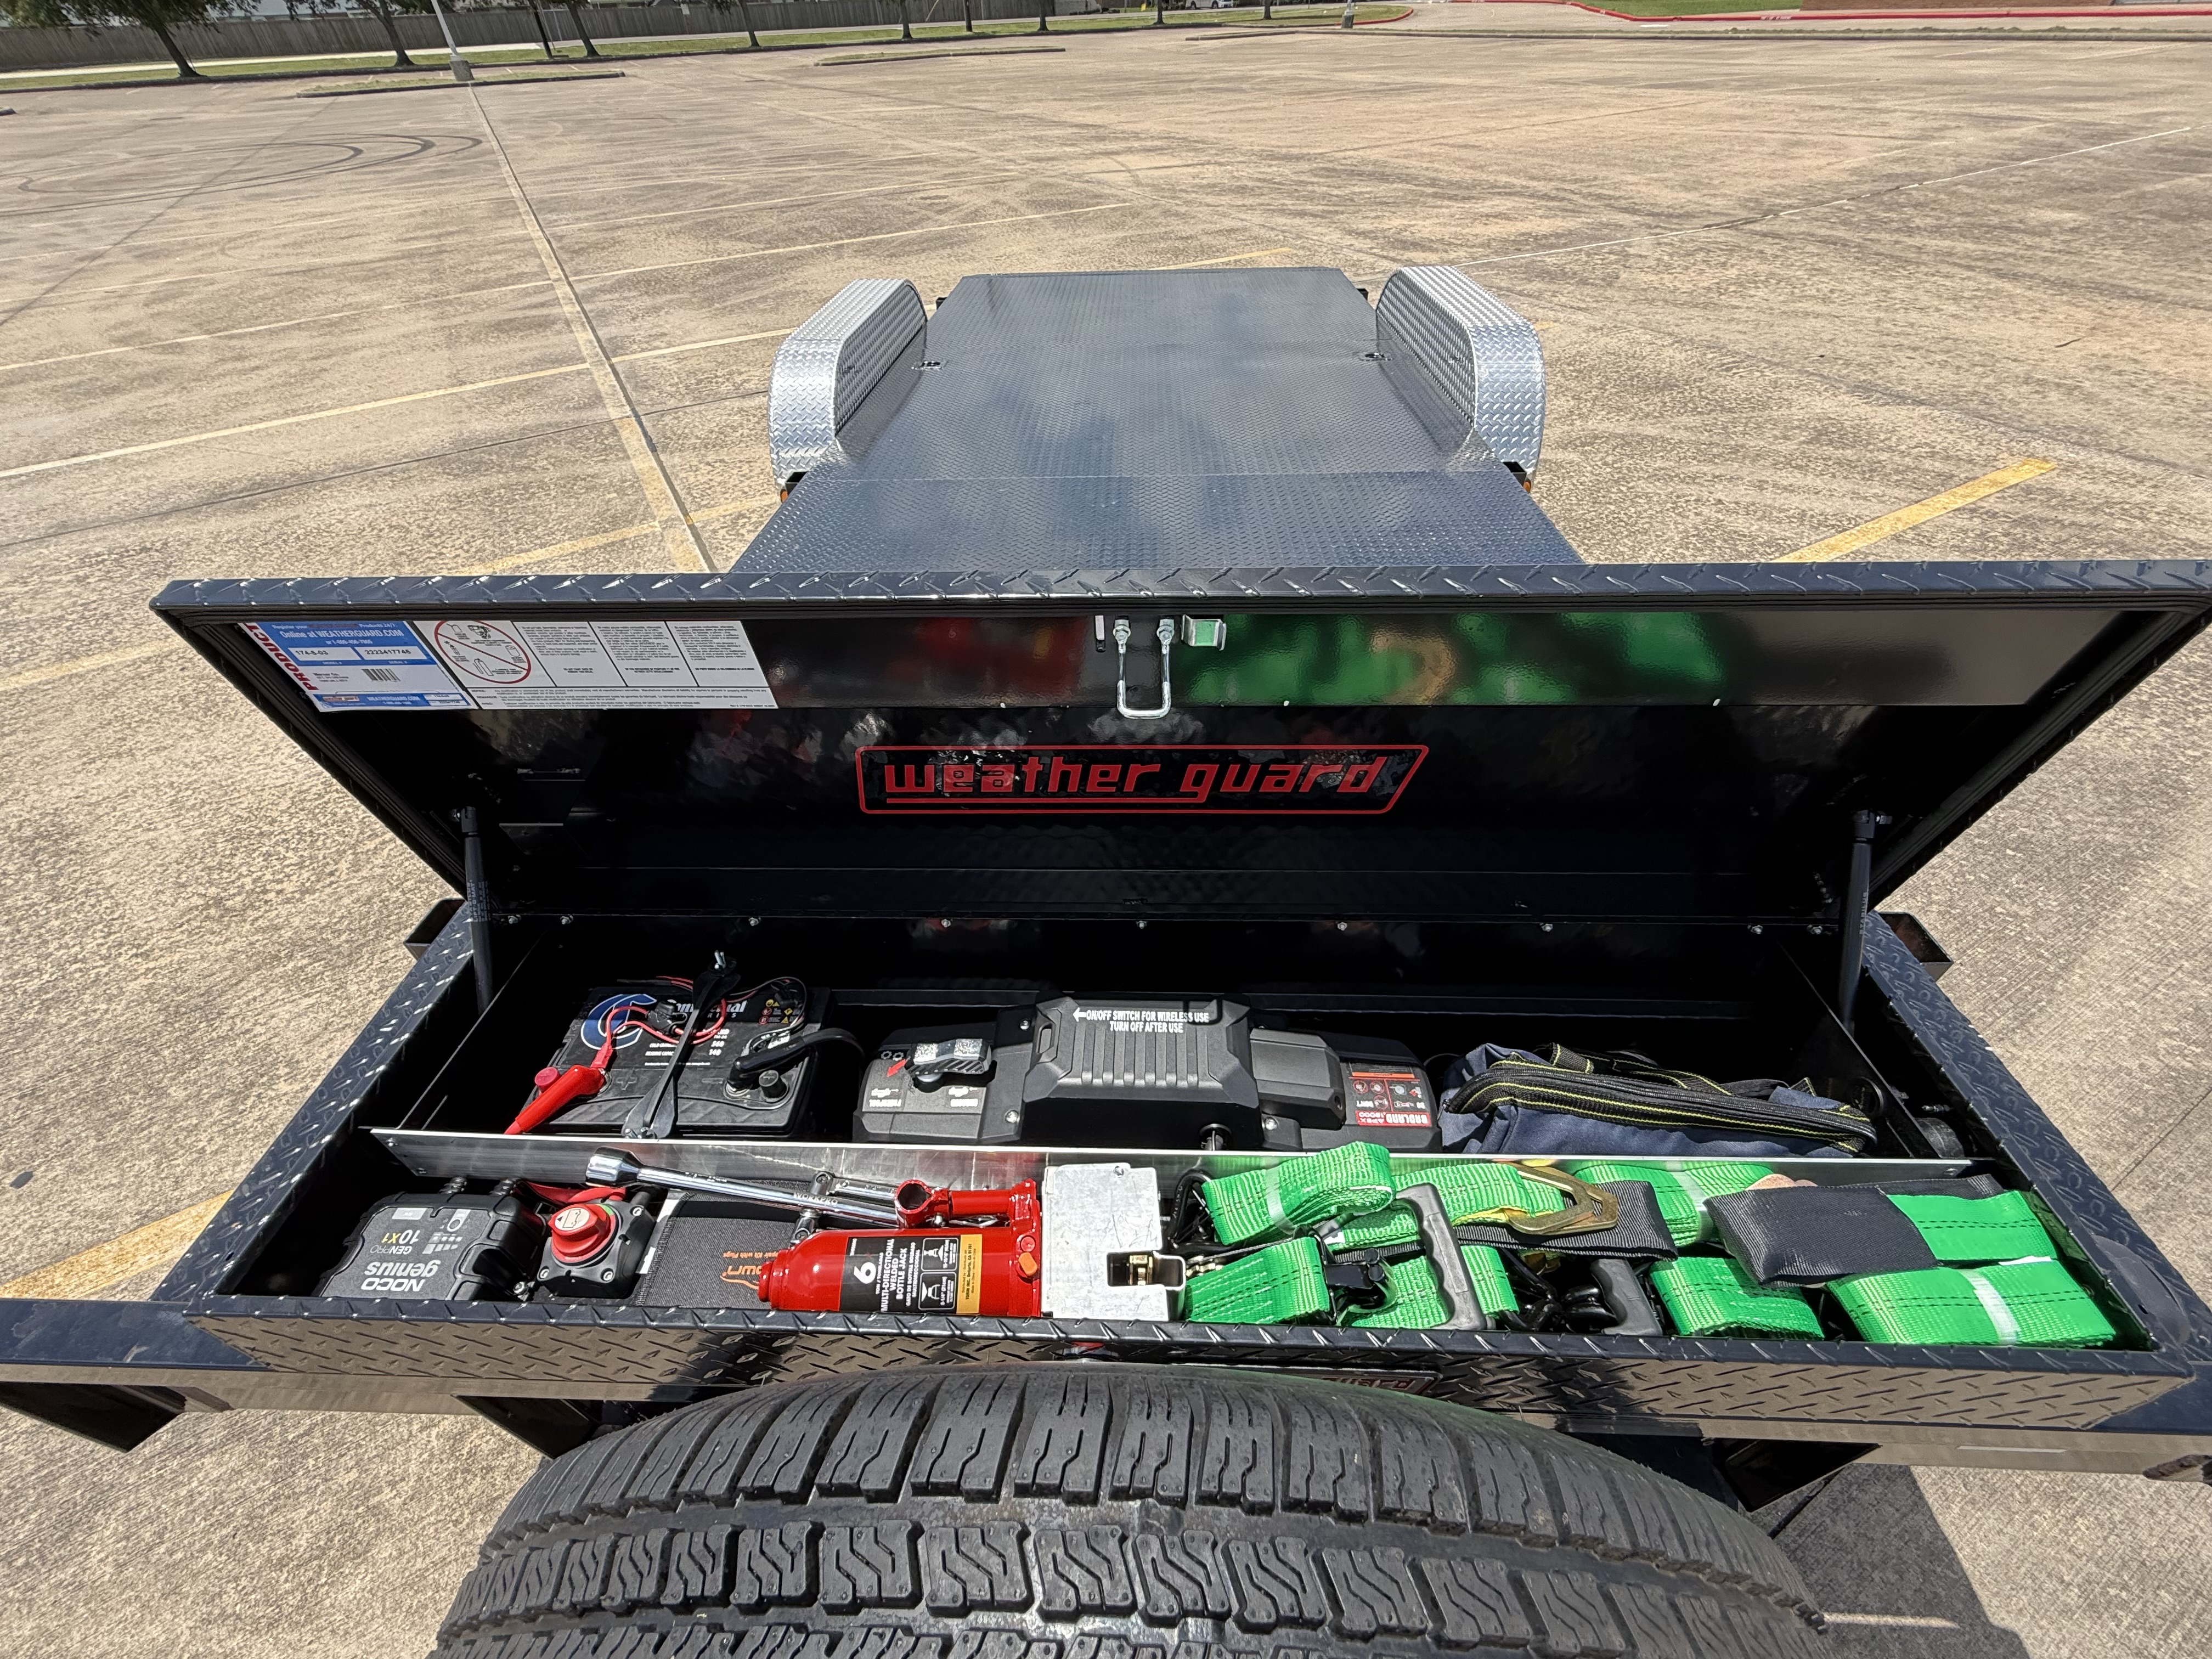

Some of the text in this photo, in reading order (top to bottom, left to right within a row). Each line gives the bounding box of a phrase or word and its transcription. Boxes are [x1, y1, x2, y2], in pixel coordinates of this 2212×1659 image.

[317, 629, 404, 637] WEATHERGUARD.COM
[243, 623, 319, 690] PRODUCT
[885, 757, 1387, 802] weather guard
[1086, 1010, 1209, 1023] ON/OFF SWITCH FOR WIRELESS USE
[1110, 1021, 1184, 1033] TURN OFF AFTER USE
[1386, 1114, 1428, 1124] BADLAND
[793, 1192, 838, 1205] WORKPRO
[381, 1229, 420, 1245] 10X1
[370, 1245, 412, 1255] GENPRO
[364, 1259, 441, 1278] genius
[854, 1262, 877, 1284] 6
[881, 1239, 895, 1313] MULTI-DIRECTIONAL
[889, 1257, 899, 1291] WELDED
[896, 1248, 907, 1300] BOTTLE JACK
[361, 1278, 426, 1292] NOCO
